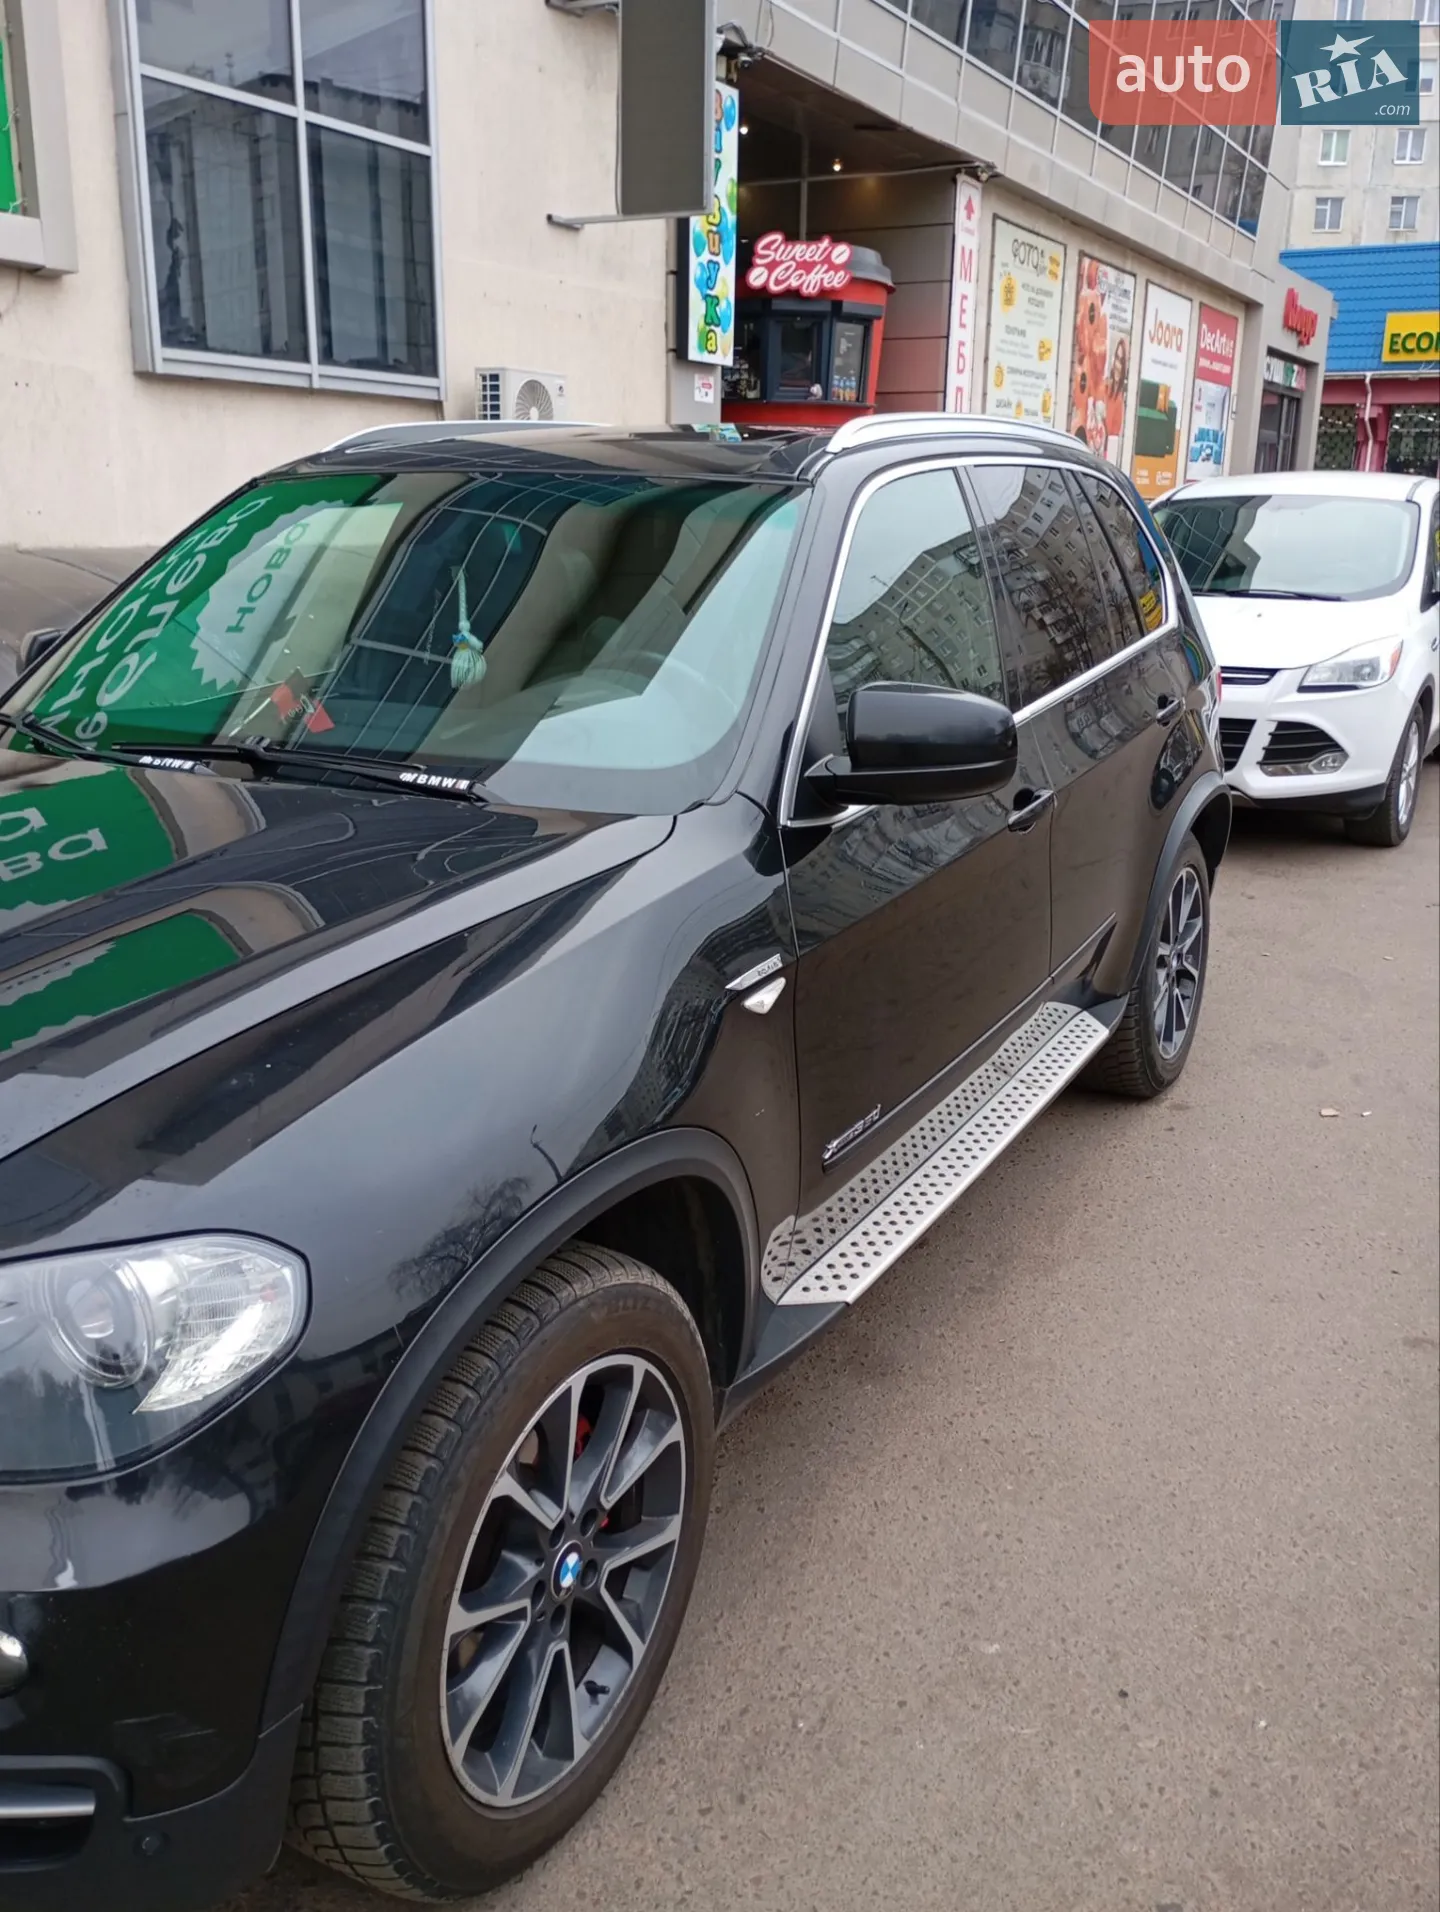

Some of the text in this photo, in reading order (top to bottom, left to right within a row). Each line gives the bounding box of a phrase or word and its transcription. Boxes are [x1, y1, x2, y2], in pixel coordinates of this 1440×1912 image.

[755, 233, 832, 264] Sweet
[769, 260, 850, 293] Coffee
[1149, 307, 1183, 352] Joora
[416, 774, 457, 788] BMW
